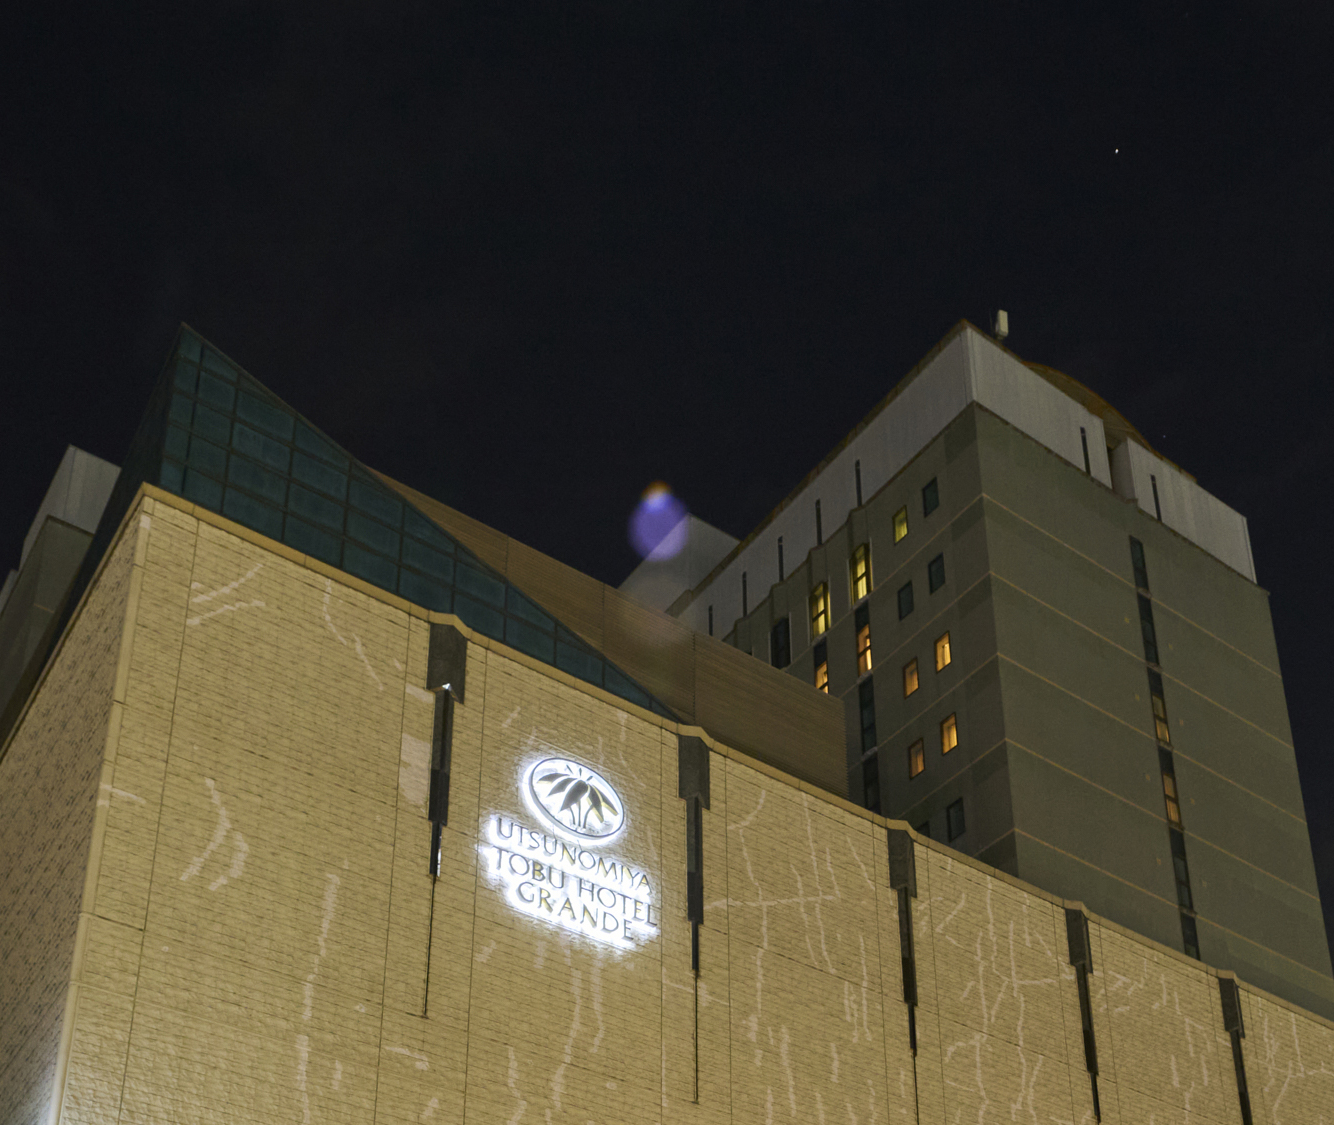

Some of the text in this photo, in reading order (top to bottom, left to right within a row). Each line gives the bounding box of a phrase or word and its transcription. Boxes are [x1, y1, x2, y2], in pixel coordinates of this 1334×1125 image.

[490, 844, 658, 928] TOBU HOTEL
[496, 816, 653, 896] UTSUNOMIYA
[516, 881, 635, 943] GRANDE
